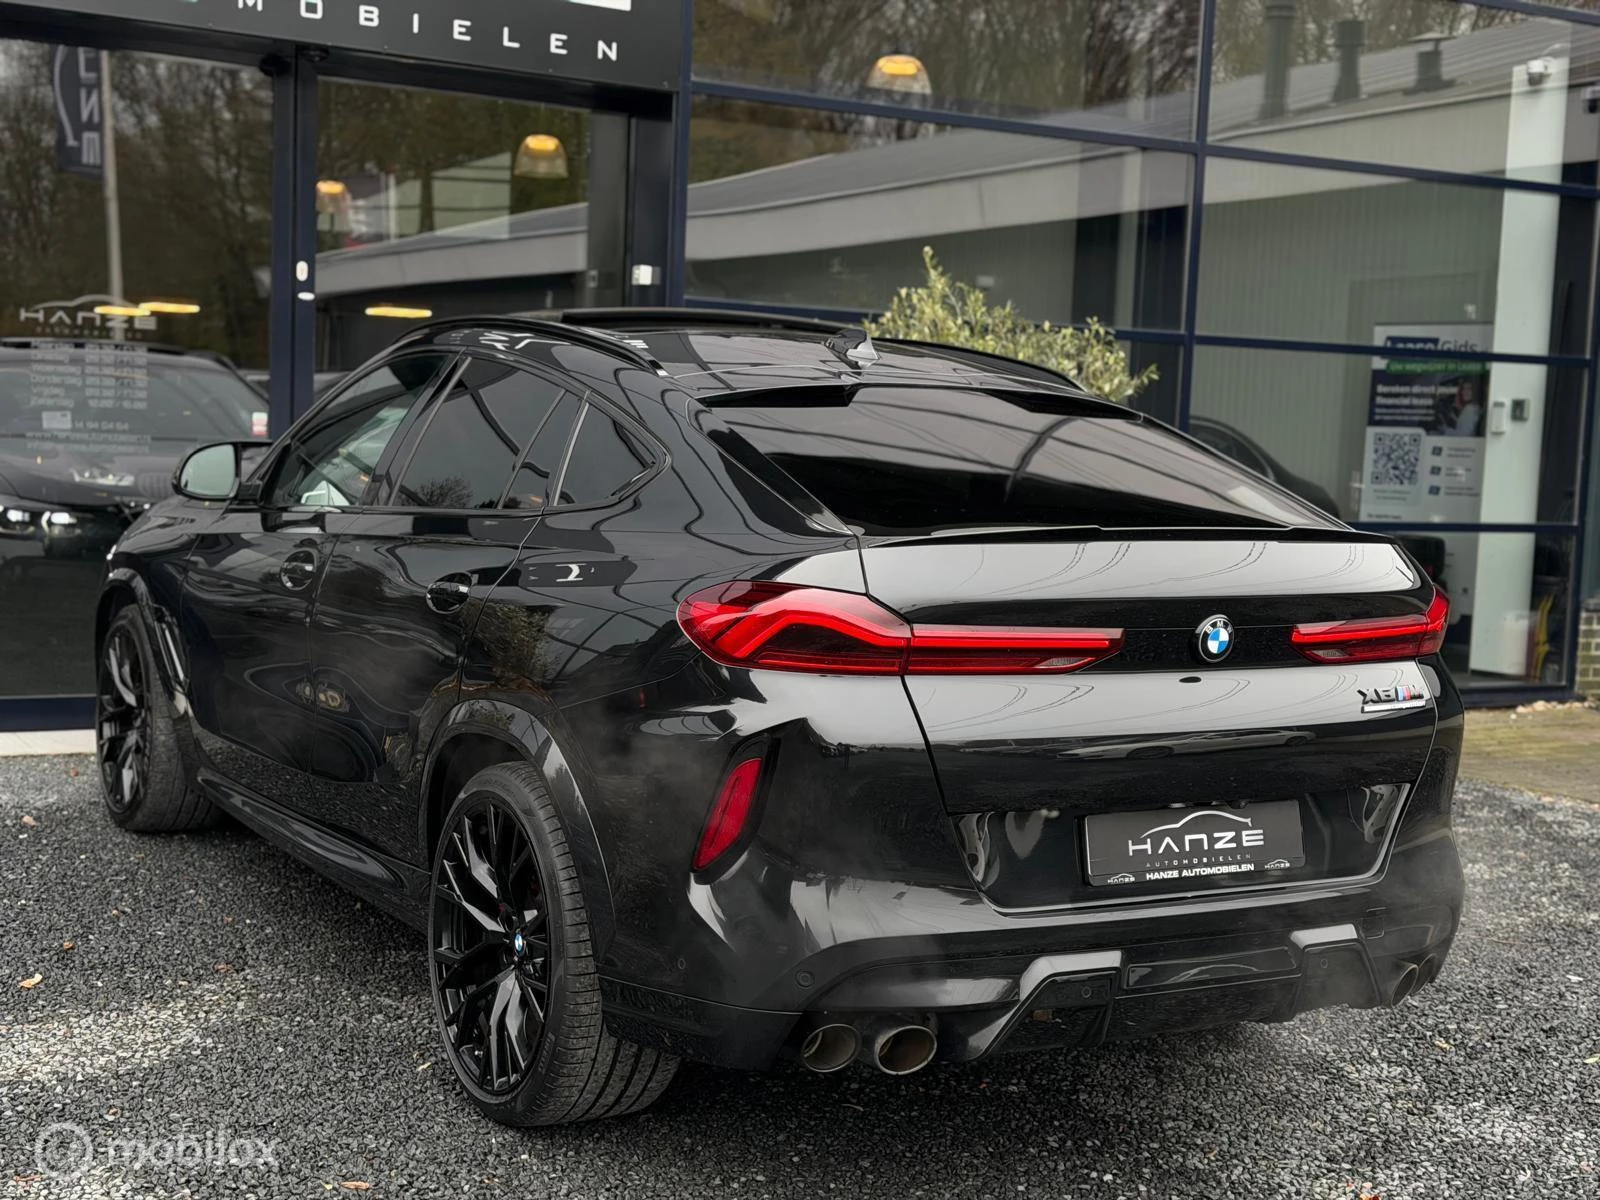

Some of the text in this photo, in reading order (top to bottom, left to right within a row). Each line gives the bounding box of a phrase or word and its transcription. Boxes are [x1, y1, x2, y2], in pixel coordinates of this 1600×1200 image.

[181, 0, 618, 62] MOBIELEN
[1128, 829, 1265, 857] HANZE
[1146, 853, 1251, 868] AUTOMOBIELEN
[1146, 863, 1255, 881] HANZE AUTOMOBIELEN
